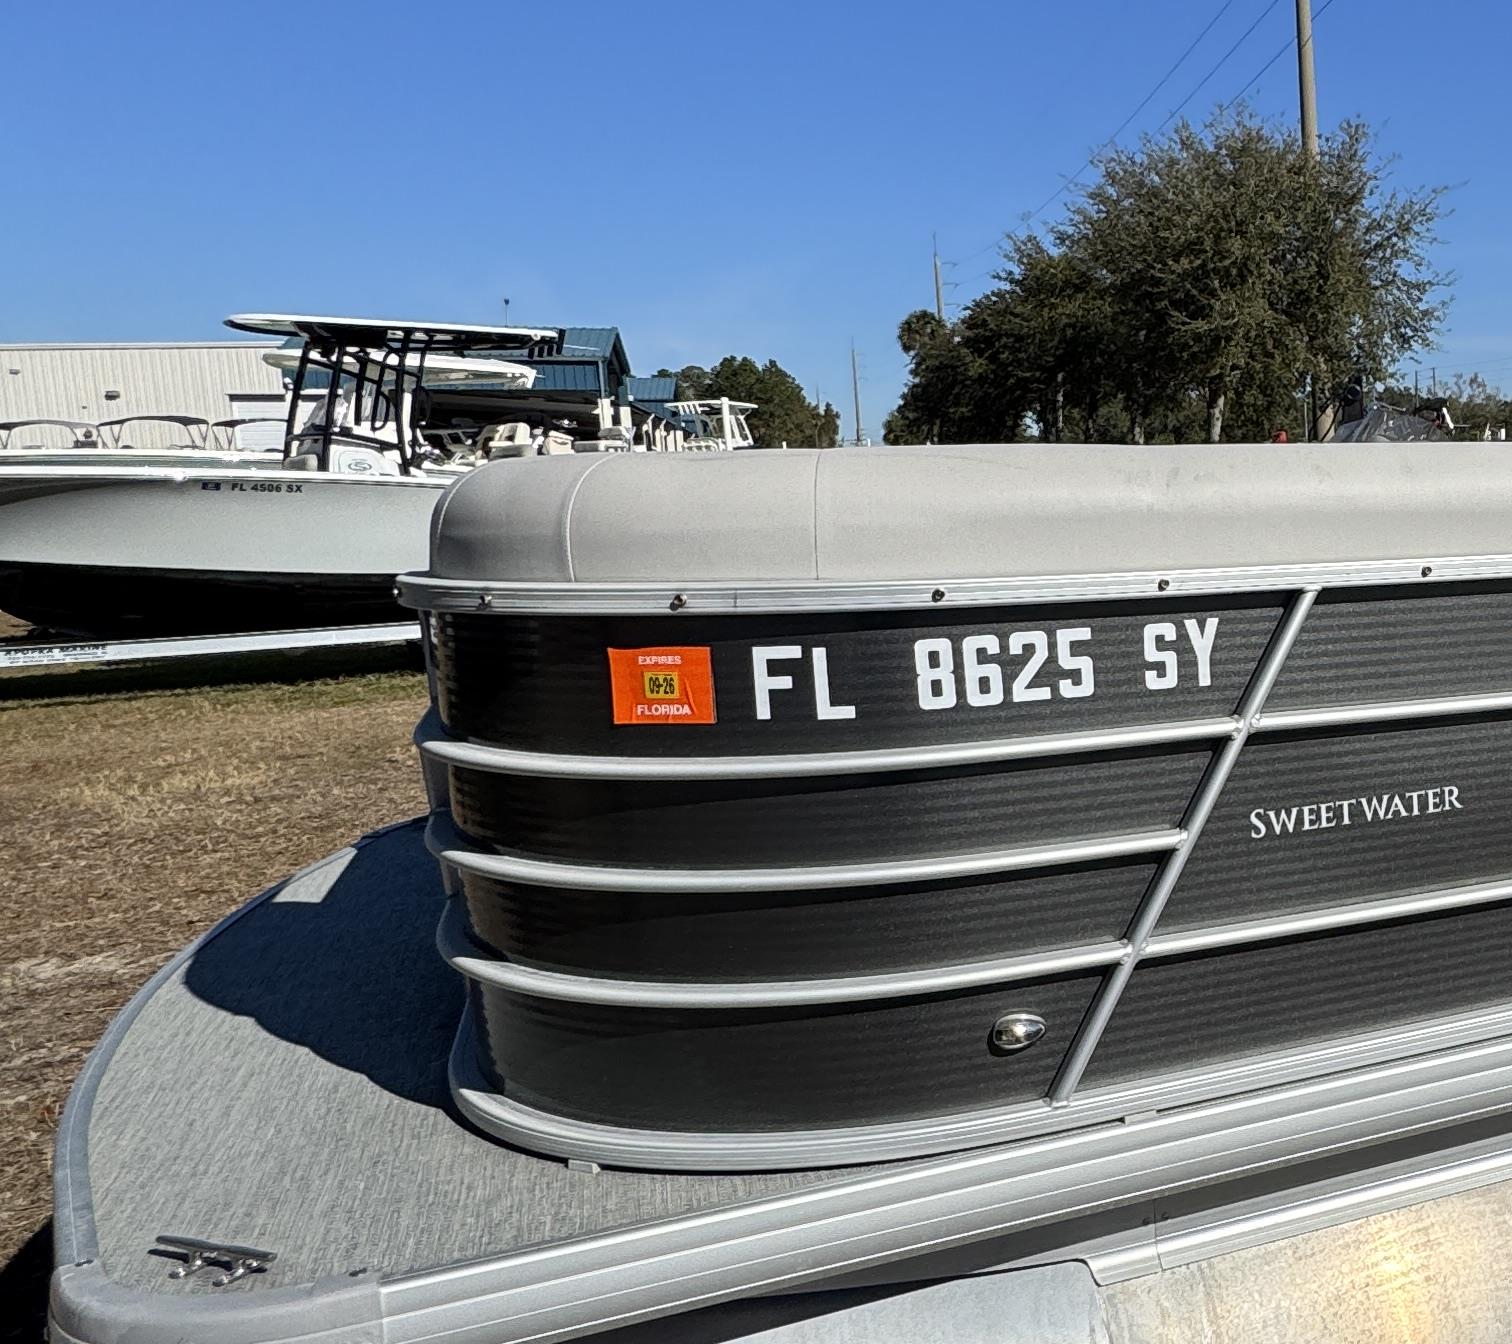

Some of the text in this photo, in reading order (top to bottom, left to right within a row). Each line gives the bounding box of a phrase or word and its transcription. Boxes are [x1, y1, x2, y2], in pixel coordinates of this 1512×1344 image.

[231, 482, 247, 492] FL
[285, 484, 303, 494] SX
[638, 655, 682, 665] EXPIRES
[751, 617, 1220, 720] FL 8625 SY
[648, 676, 676, 695] 09-26
[636, 704, 692, 716] FLORIDA
[1249, 785, 1464, 840] SWEETWATER
